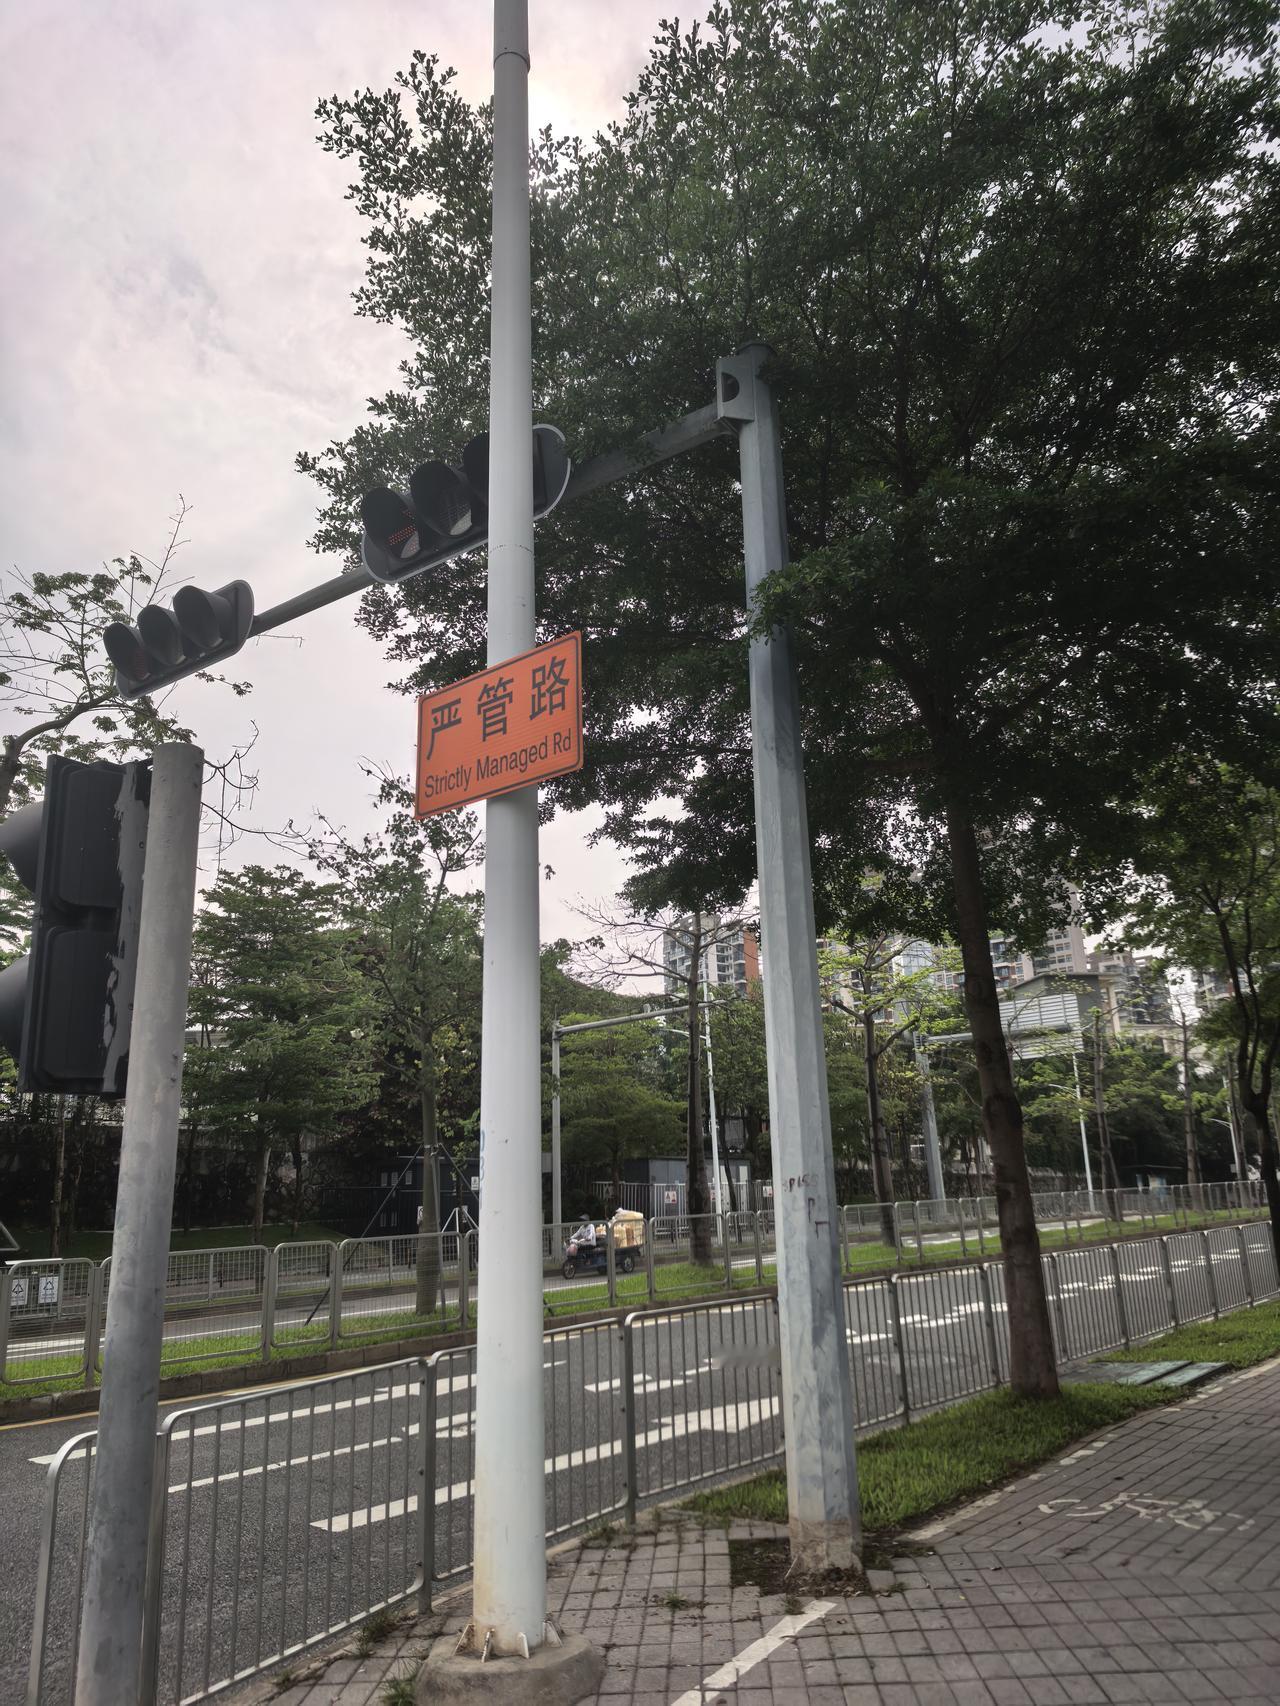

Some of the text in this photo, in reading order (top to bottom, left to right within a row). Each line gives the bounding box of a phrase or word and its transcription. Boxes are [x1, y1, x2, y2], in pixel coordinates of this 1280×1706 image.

[427, 655, 570, 760] 严管路
[424, 728, 572, 798] Strictly Managed Rd
